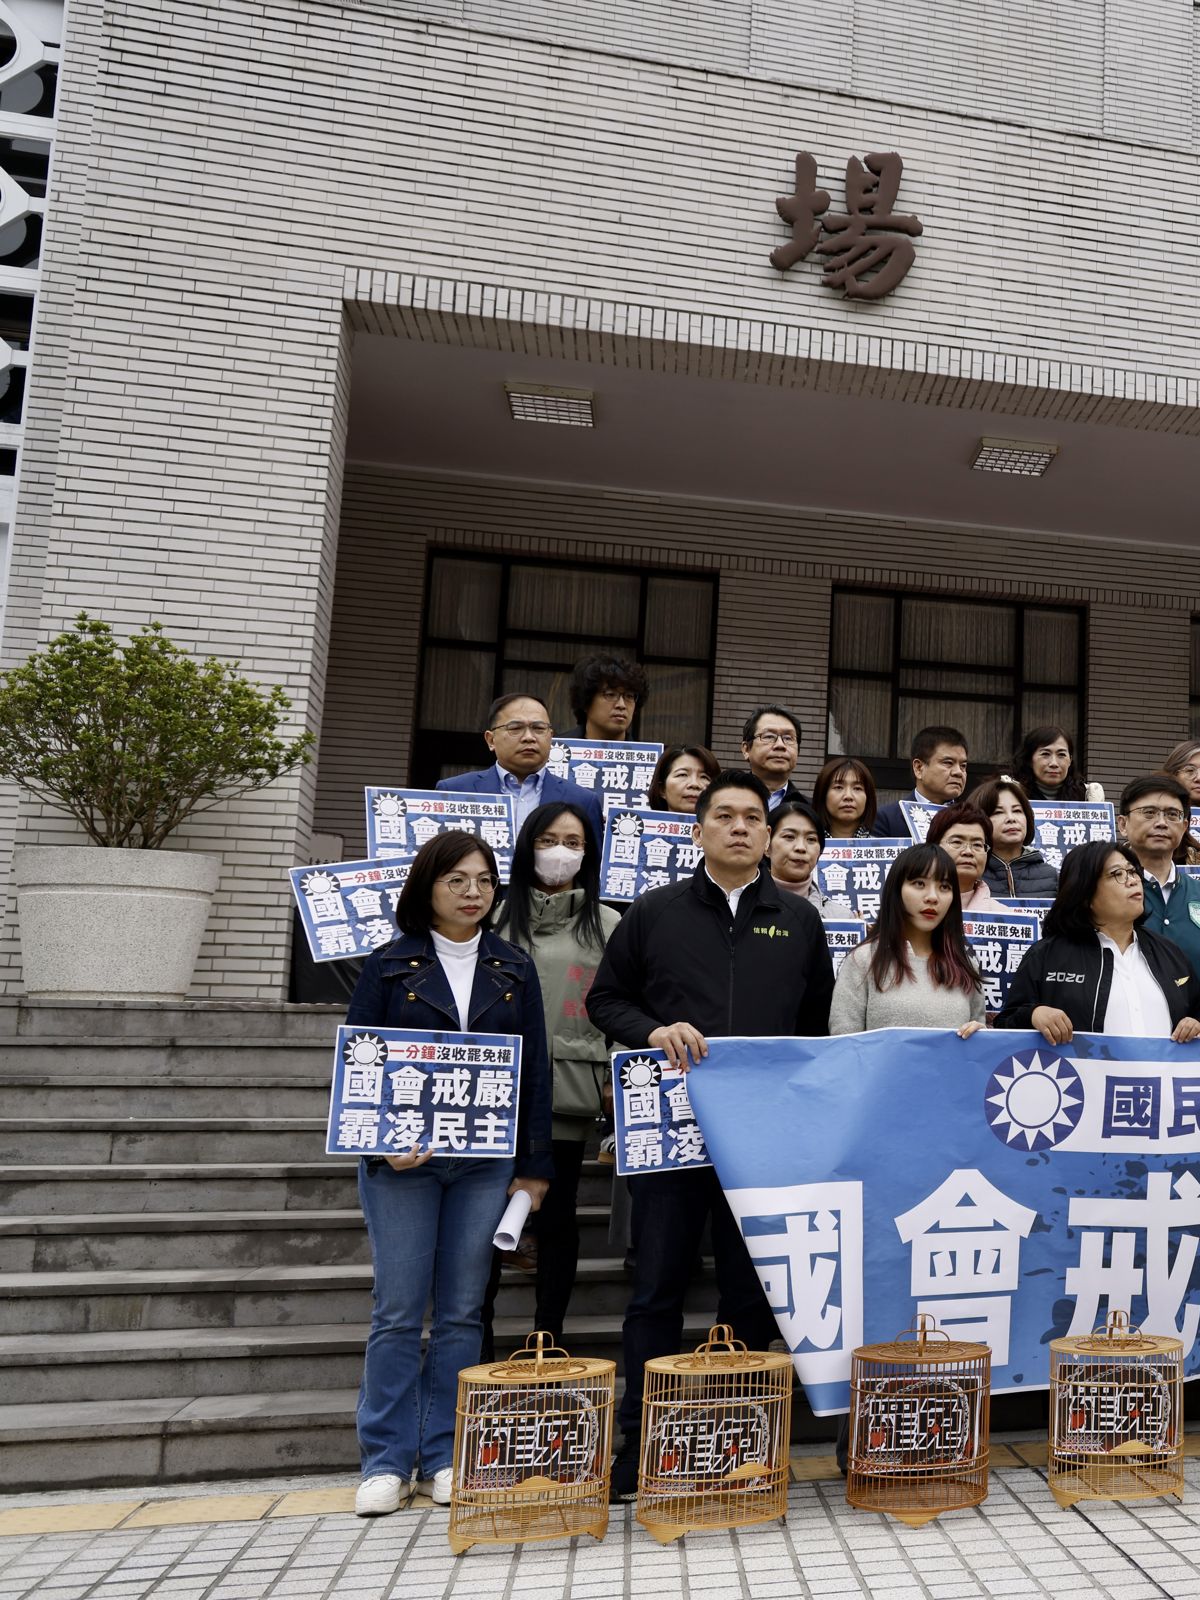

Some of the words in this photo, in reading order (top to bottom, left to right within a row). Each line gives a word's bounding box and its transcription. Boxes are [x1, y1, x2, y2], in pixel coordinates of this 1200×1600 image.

[769, 151, 923, 300] 場
[572, 749, 656, 762] 一分鐘沒收罷免權
[408, 801, 507, 817] 一分鐘沒收罷免權
[1035, 809, 1109, 820] 一分鐘沒收罷免權
[645, 823, 692, 836] 一分鐘沒
[609, 834, 704, 869] 國會戒
[340, 866, 411, 883] 一分鐘沒收
[605, 866, 694, 897] 霸凌
[821, 863, 892, 891] 會戒
[315, 918, 395, 955] 霸凌
[1046, 972, 1085, 984] 2020
[389, 1044, 512, 1063] 一分鐘沒收罷免權
[341, 1065, 514, 1108] 國會戒嚴
[336, 1108, 510, 1151] 霸凌民主
[624, 1123, 707, 1169] 霸凌
